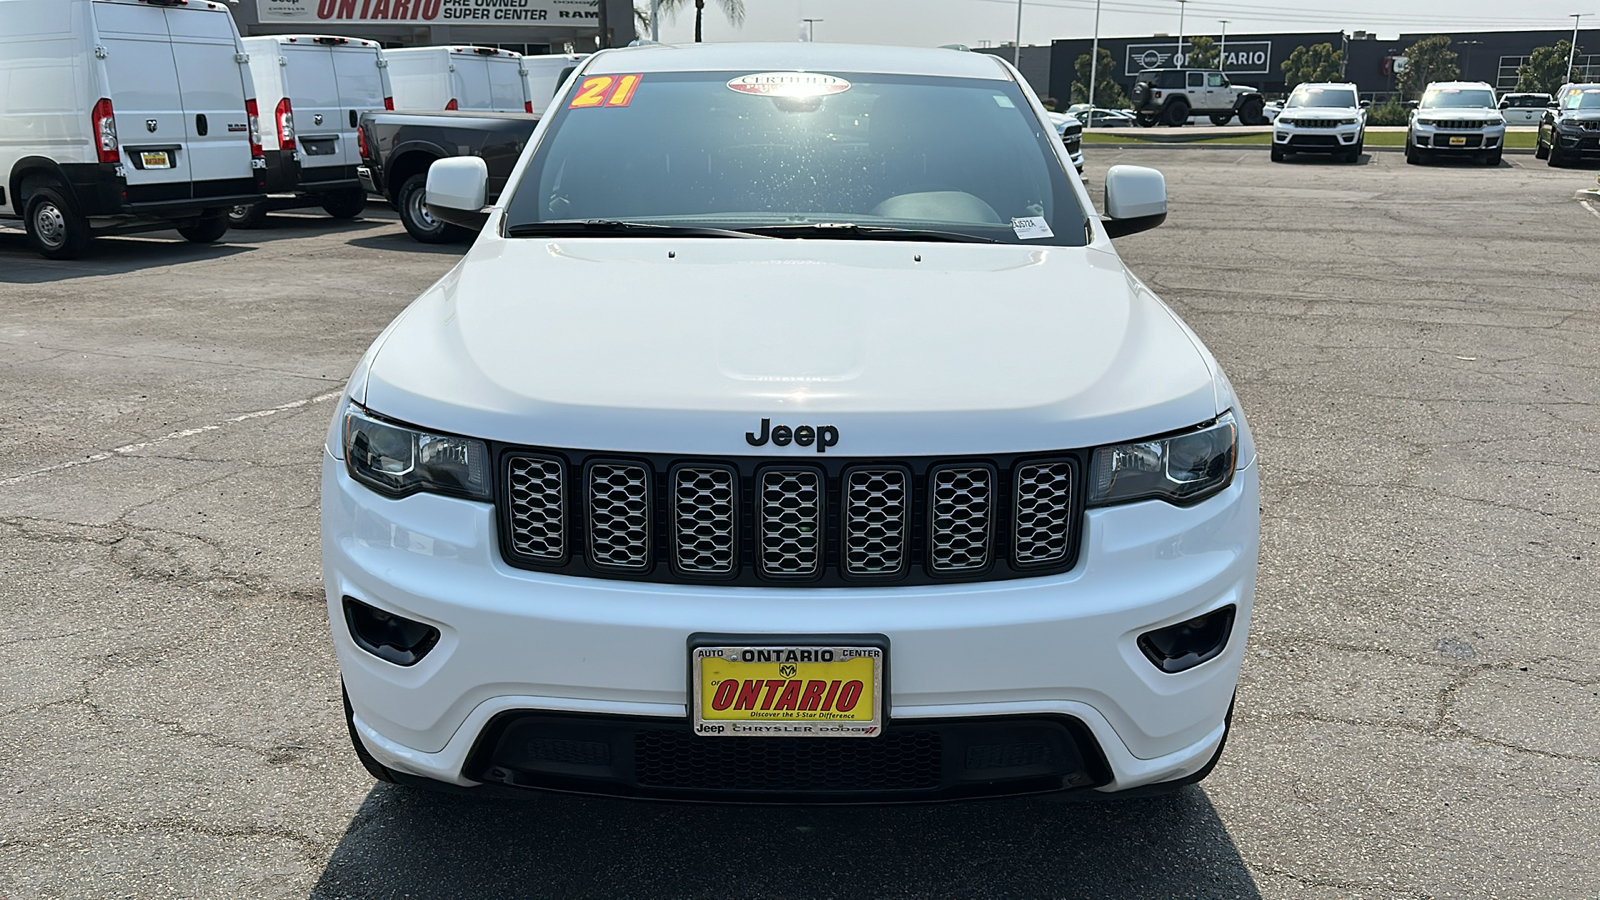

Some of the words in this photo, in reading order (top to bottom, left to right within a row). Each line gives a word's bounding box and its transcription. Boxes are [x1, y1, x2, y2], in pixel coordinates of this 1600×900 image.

[317, 0, 441, 20] ONTARIO
[443, 8, 491, 19] SUPER
[494, 8, 547, 20] CENTER
[571, 75, 638, 106] 21
[745, 418, 839, 453] Jeep
[698, 650, 724, 658] AUTO
[742, 649, 834, 663] ONTARIO
[842, 649, 880, 658] CENTER
[711, 679, 864, 712] ONTARIO
[819, 712, 855, 720] Difference
[696, 723, 725, 734] Jeep
[733, 725, 812, 733] CHRYSLER
